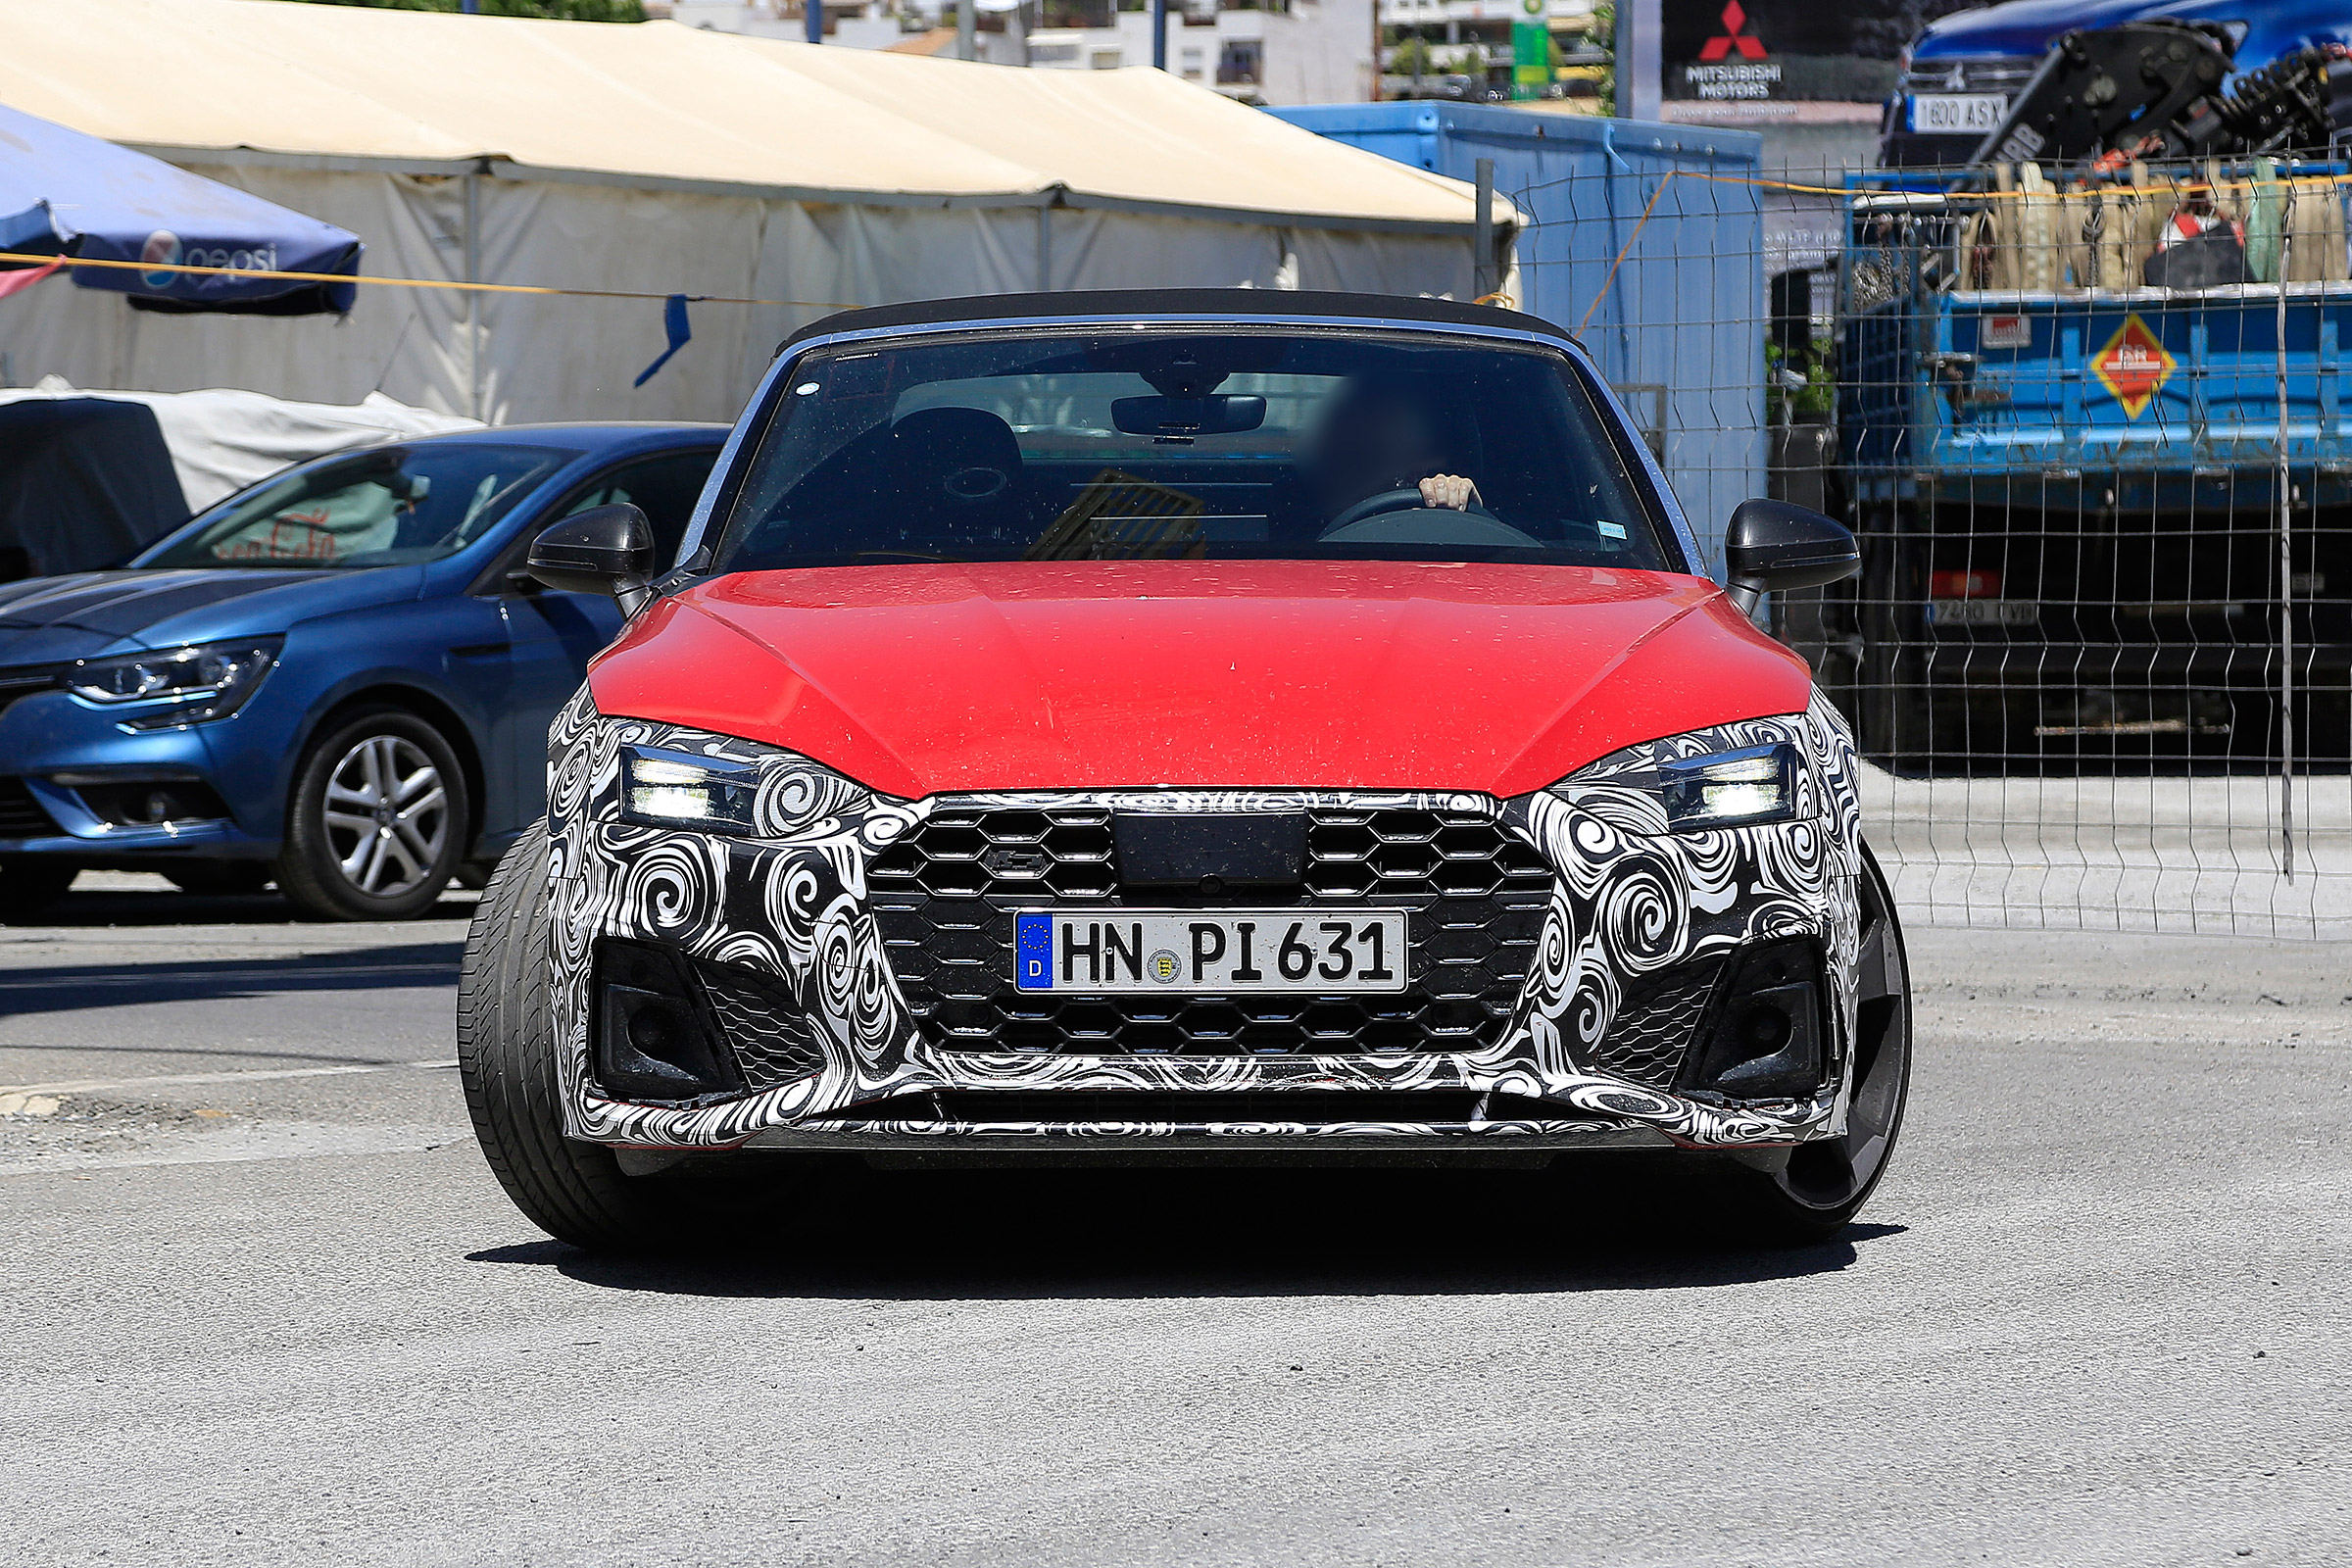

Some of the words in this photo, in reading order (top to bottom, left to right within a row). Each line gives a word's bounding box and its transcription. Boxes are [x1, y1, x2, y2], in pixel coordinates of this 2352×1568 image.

[1686, 65, 1782, 83] MITSUBISHI
[1698, 81, 1769, 99] MOTORS
[1965, 99, 2003, 126] ASX
[185, 243, 277, 283] pepsi
[1061, 922, 1143, 982] HN
[1188, 922, 1263, 982] PI
[1277, 921, 1395, 982] 631
[1029, 959, 1043, 977] D
